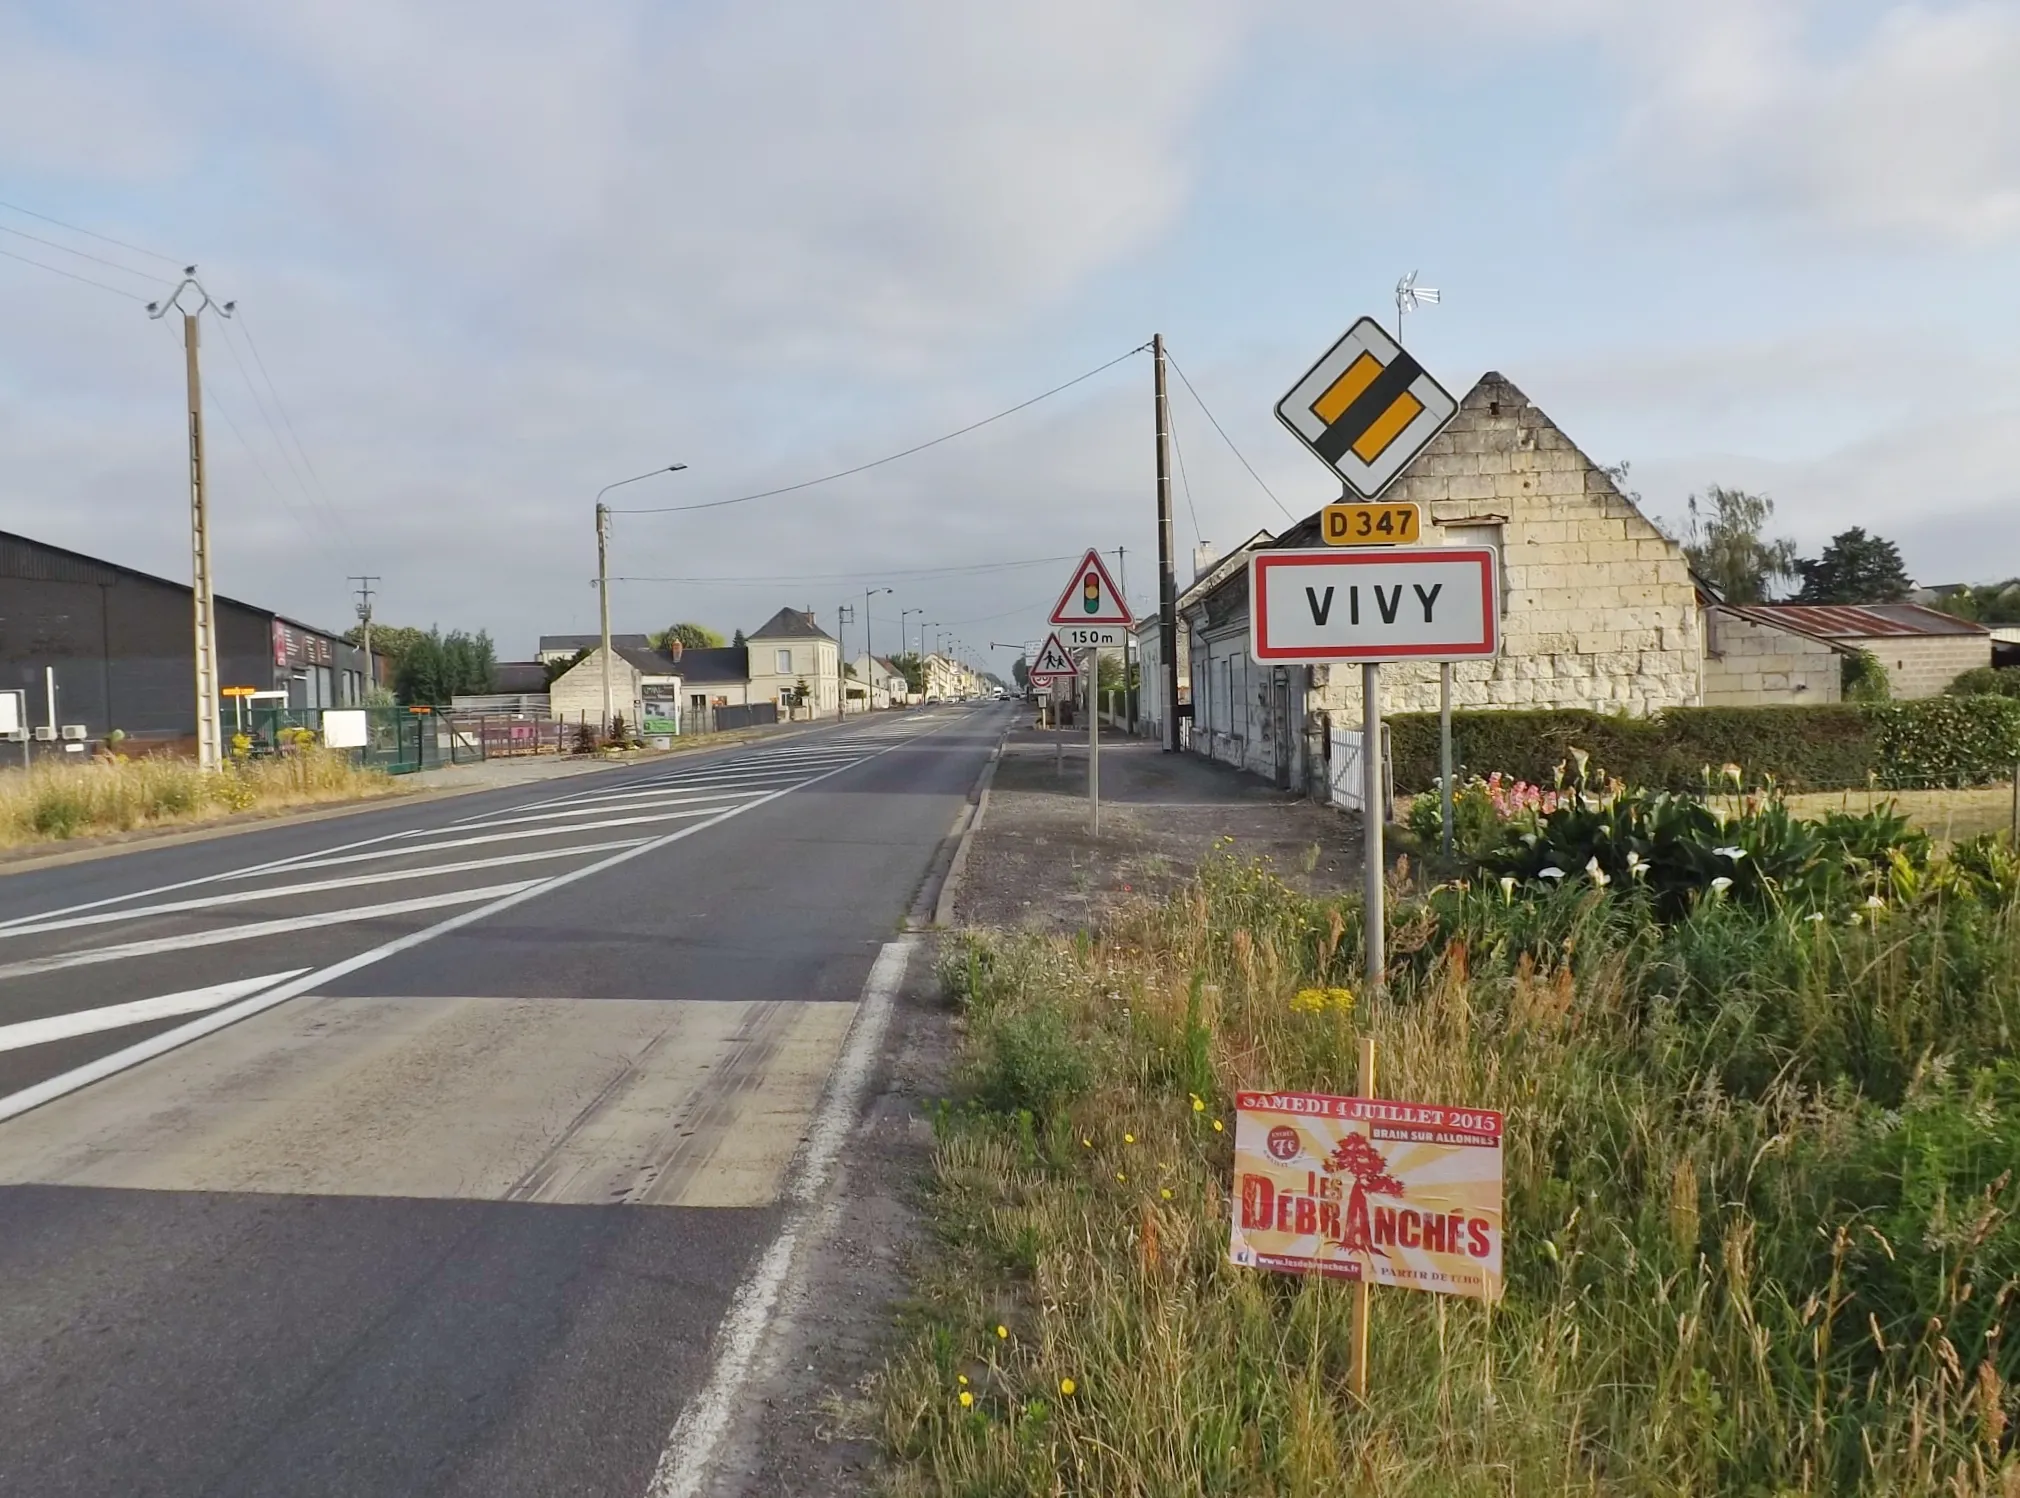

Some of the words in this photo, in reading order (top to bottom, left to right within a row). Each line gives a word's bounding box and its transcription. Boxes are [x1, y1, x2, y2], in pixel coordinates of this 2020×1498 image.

[1329, 512, 1348, 537] D
[1355, 510, 1413, 536] 347
[1305, 583, 1443, 626] VIVY
[1071, 630, 1099, 644] 150
[1101, 634, 1113, 643] m
[1242, 1094, 1332, 1115] SAMEDI
[1335, 1101, 1347, 1116] 4
[1350, 1102, 1445, 1125] JUILLET
[1448, 1111, 1496, 1131] 2015
[1373, 1128, 1408, 1140] BRAIN
[1411, 1131, 1433, 1142] SUR
[1436, 1132, 1494, 1146] ALLONNES
[1307, 1170, 1343, 1201] LES
[1380, 1267, 1428, 1280] PARTIR
[1431, 1272, 1448, 1282] DE
